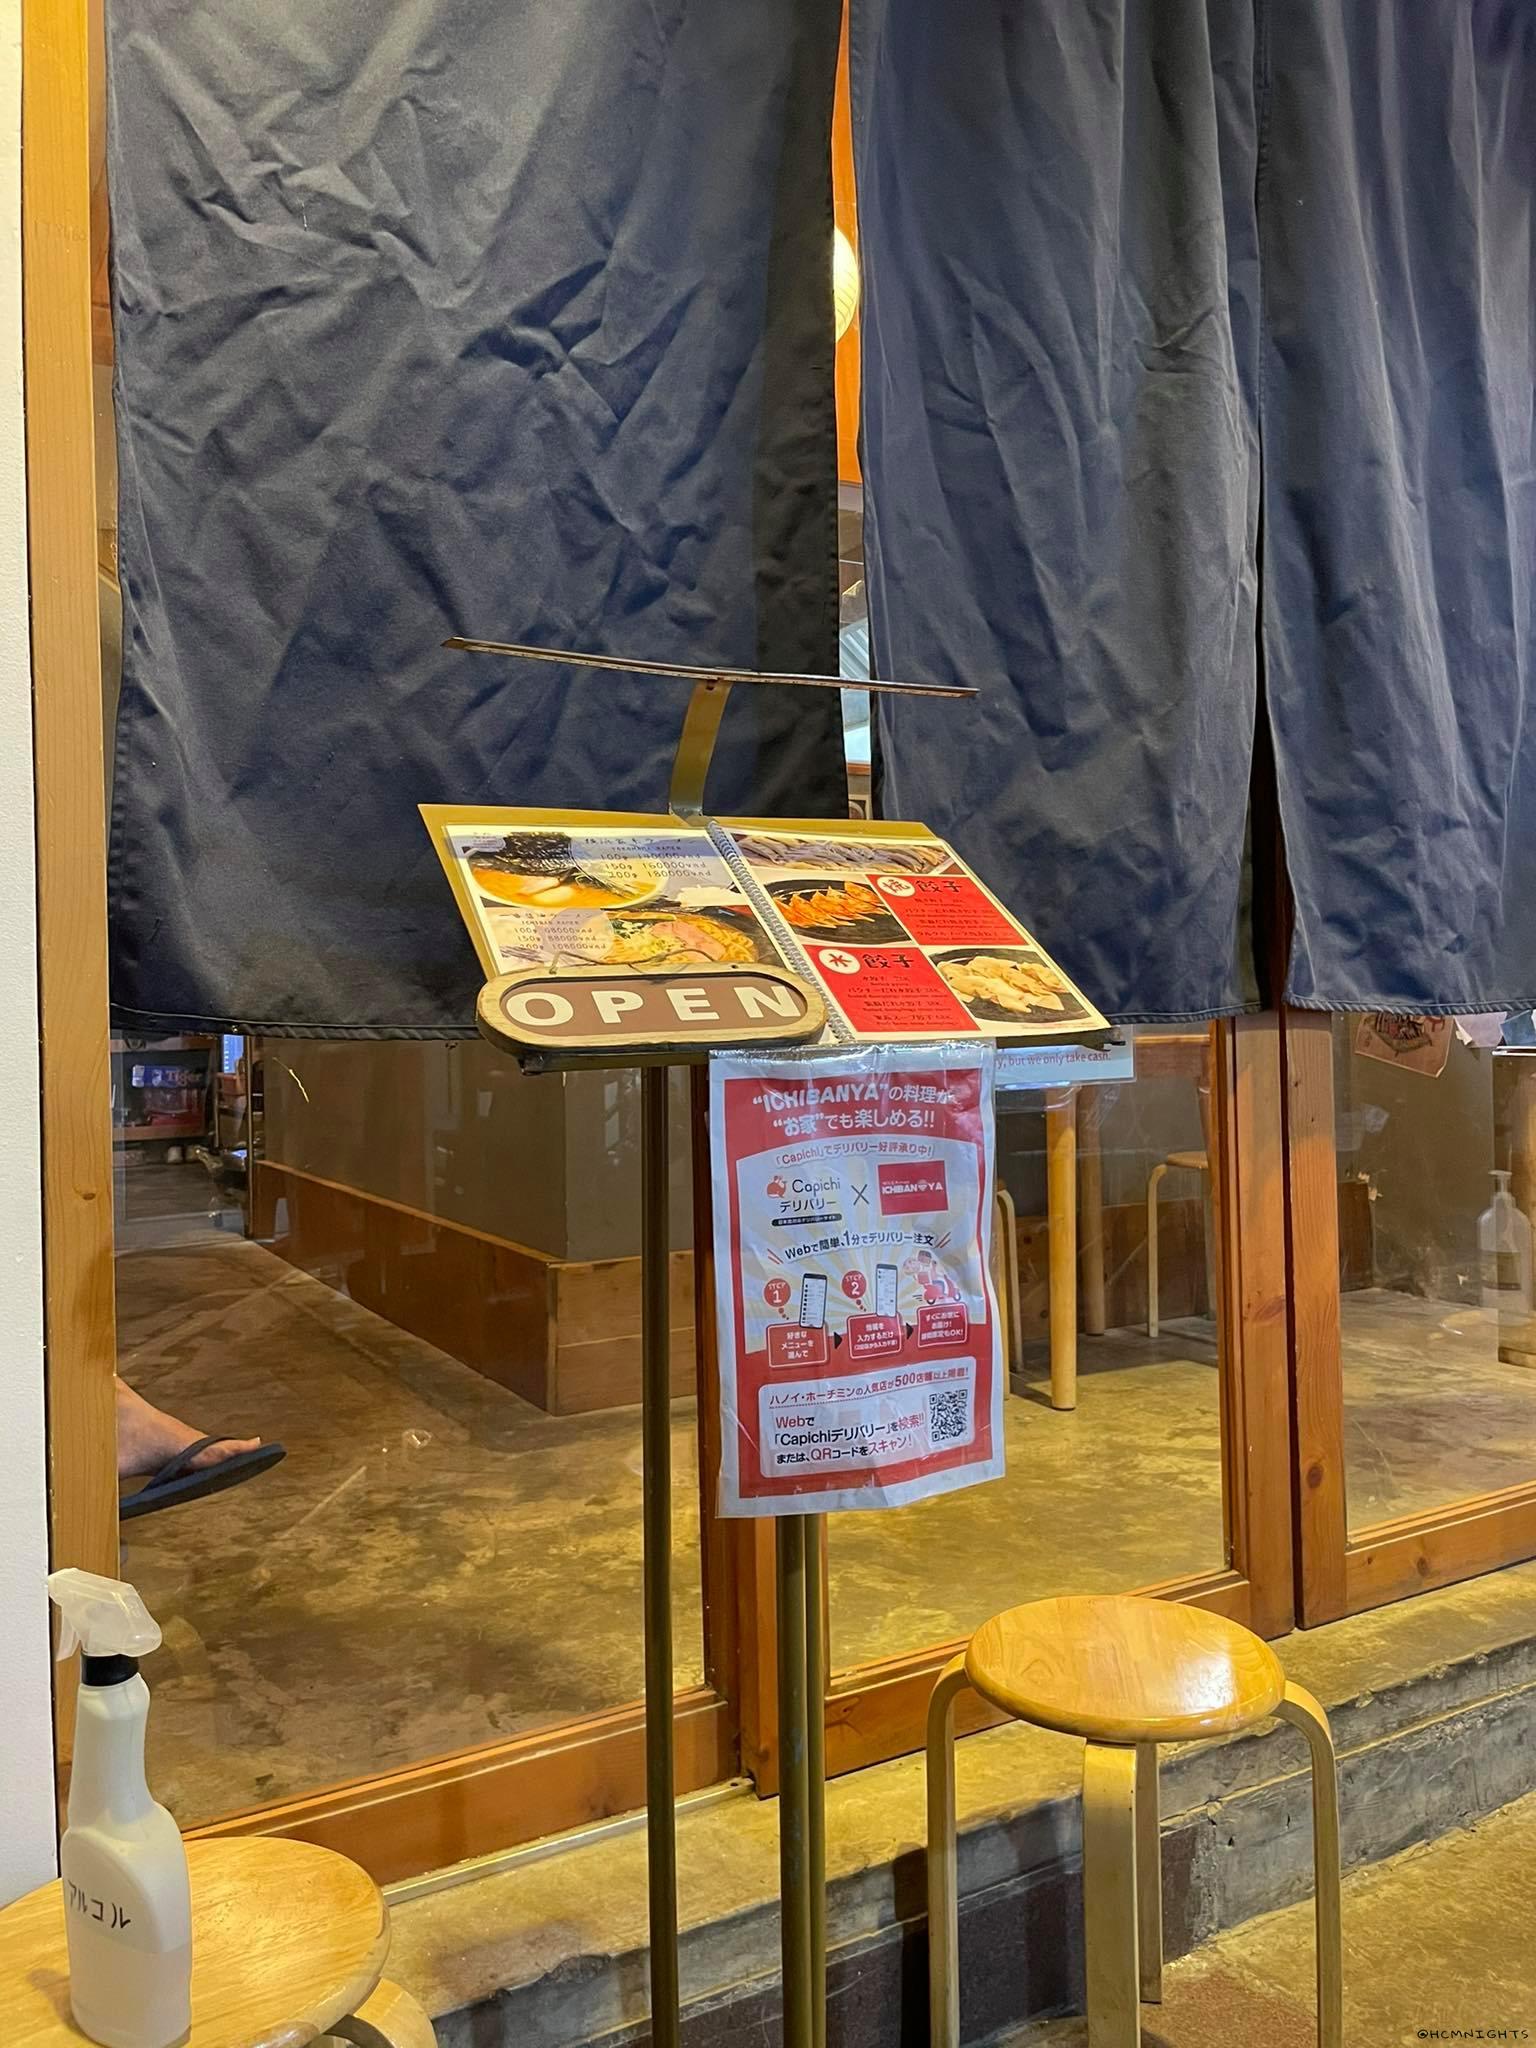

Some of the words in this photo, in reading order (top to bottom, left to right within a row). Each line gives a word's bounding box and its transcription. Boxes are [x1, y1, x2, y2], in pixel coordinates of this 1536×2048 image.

[505, 985, 802, 1026] OPEN
[1009, 1056, 1025, 1066] but
[1027, 1055, 1042, 1065] we
[1044, 1052, 1064, 1066] only
[1066, 1051, 1087, 1062] take
[1088, 1050, 1111, 1062] cash.
[791, 1178, 841, 1201] Capichi
[780, 1200, 837, 1213] デリバリー
[851, 1281, 860, 1295] 2
[773, 1290, 782, 1303] 1
[775, 1416, 815, 1429] Webで
